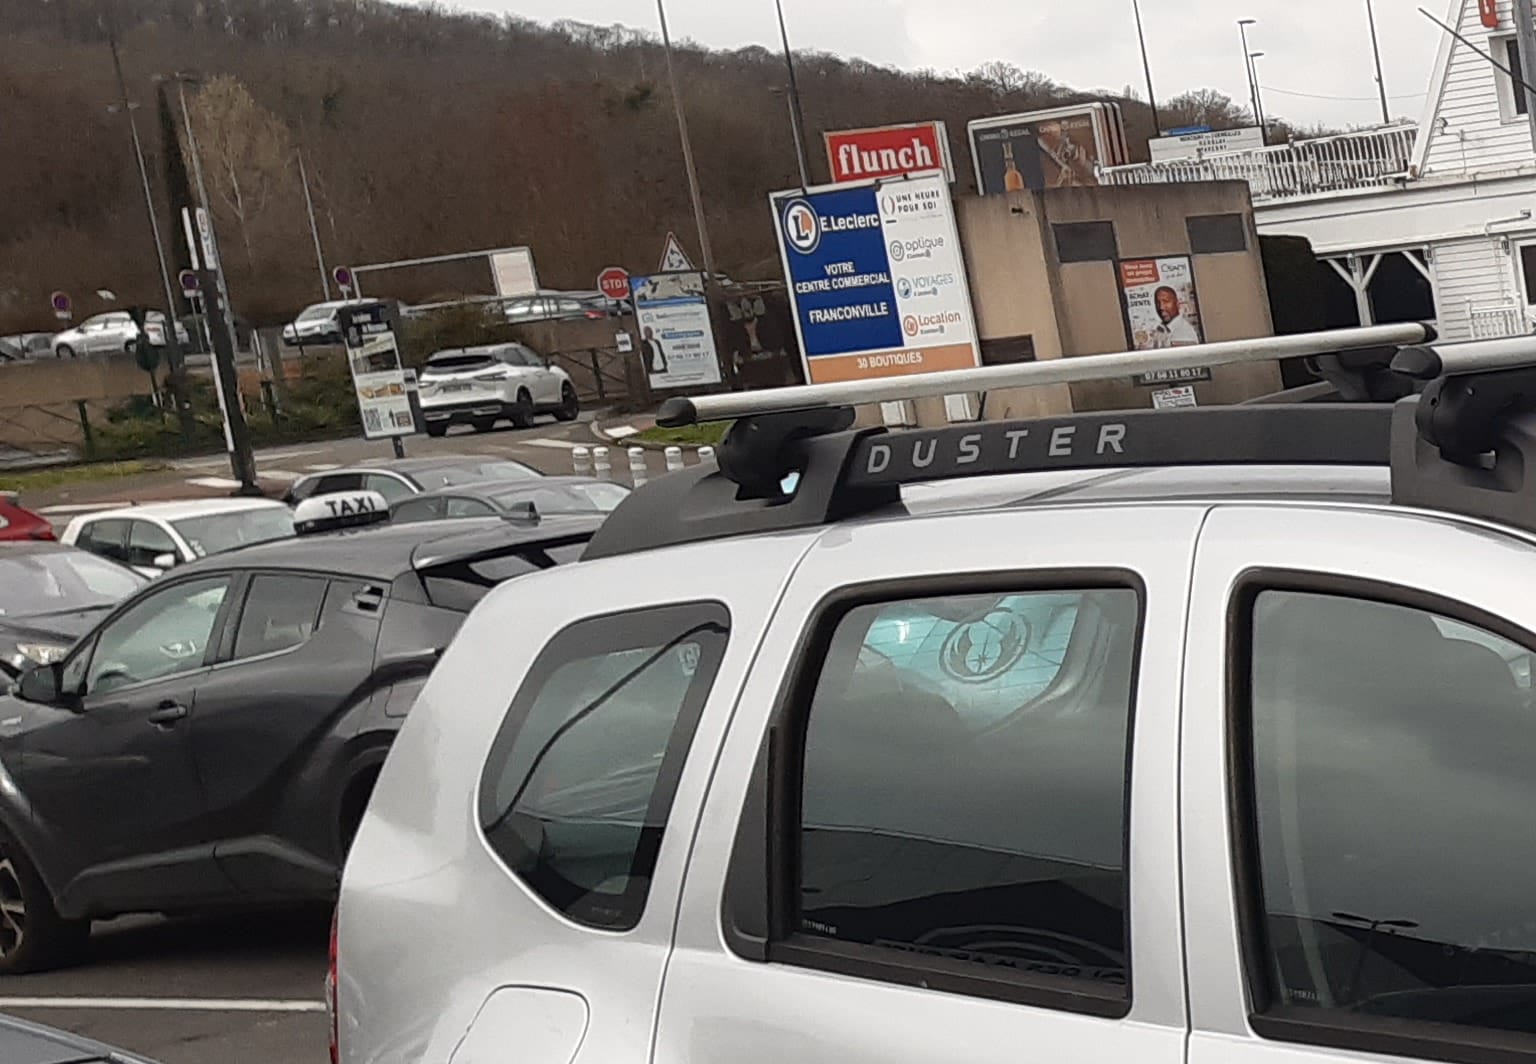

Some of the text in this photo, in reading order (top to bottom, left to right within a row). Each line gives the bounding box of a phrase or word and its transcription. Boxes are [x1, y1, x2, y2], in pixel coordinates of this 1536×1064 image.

[839, 137, 934, 175] flunch
[896, 189, 940, 203] UNE HEURE
[898, 201, 937, 213] POUR SOI
[820, 214, 880, 232] E.Leclerc
[905, 237, 944, 252] optique
[824, 261, 855, 276] VOTRE
[796, 272, 890, 294] CENTRE COMMERCIAL
[912, 273, 954, 288] VOYAGES
[809, 302, 888, 324] FRANCONVILLE
[918, 310, 961, 326] Location
[869, 351, 923, 368] BOUTIQUES
[867, 424, 1126, 473] DUSTER
[325, 496, 375, 516] TAXI
